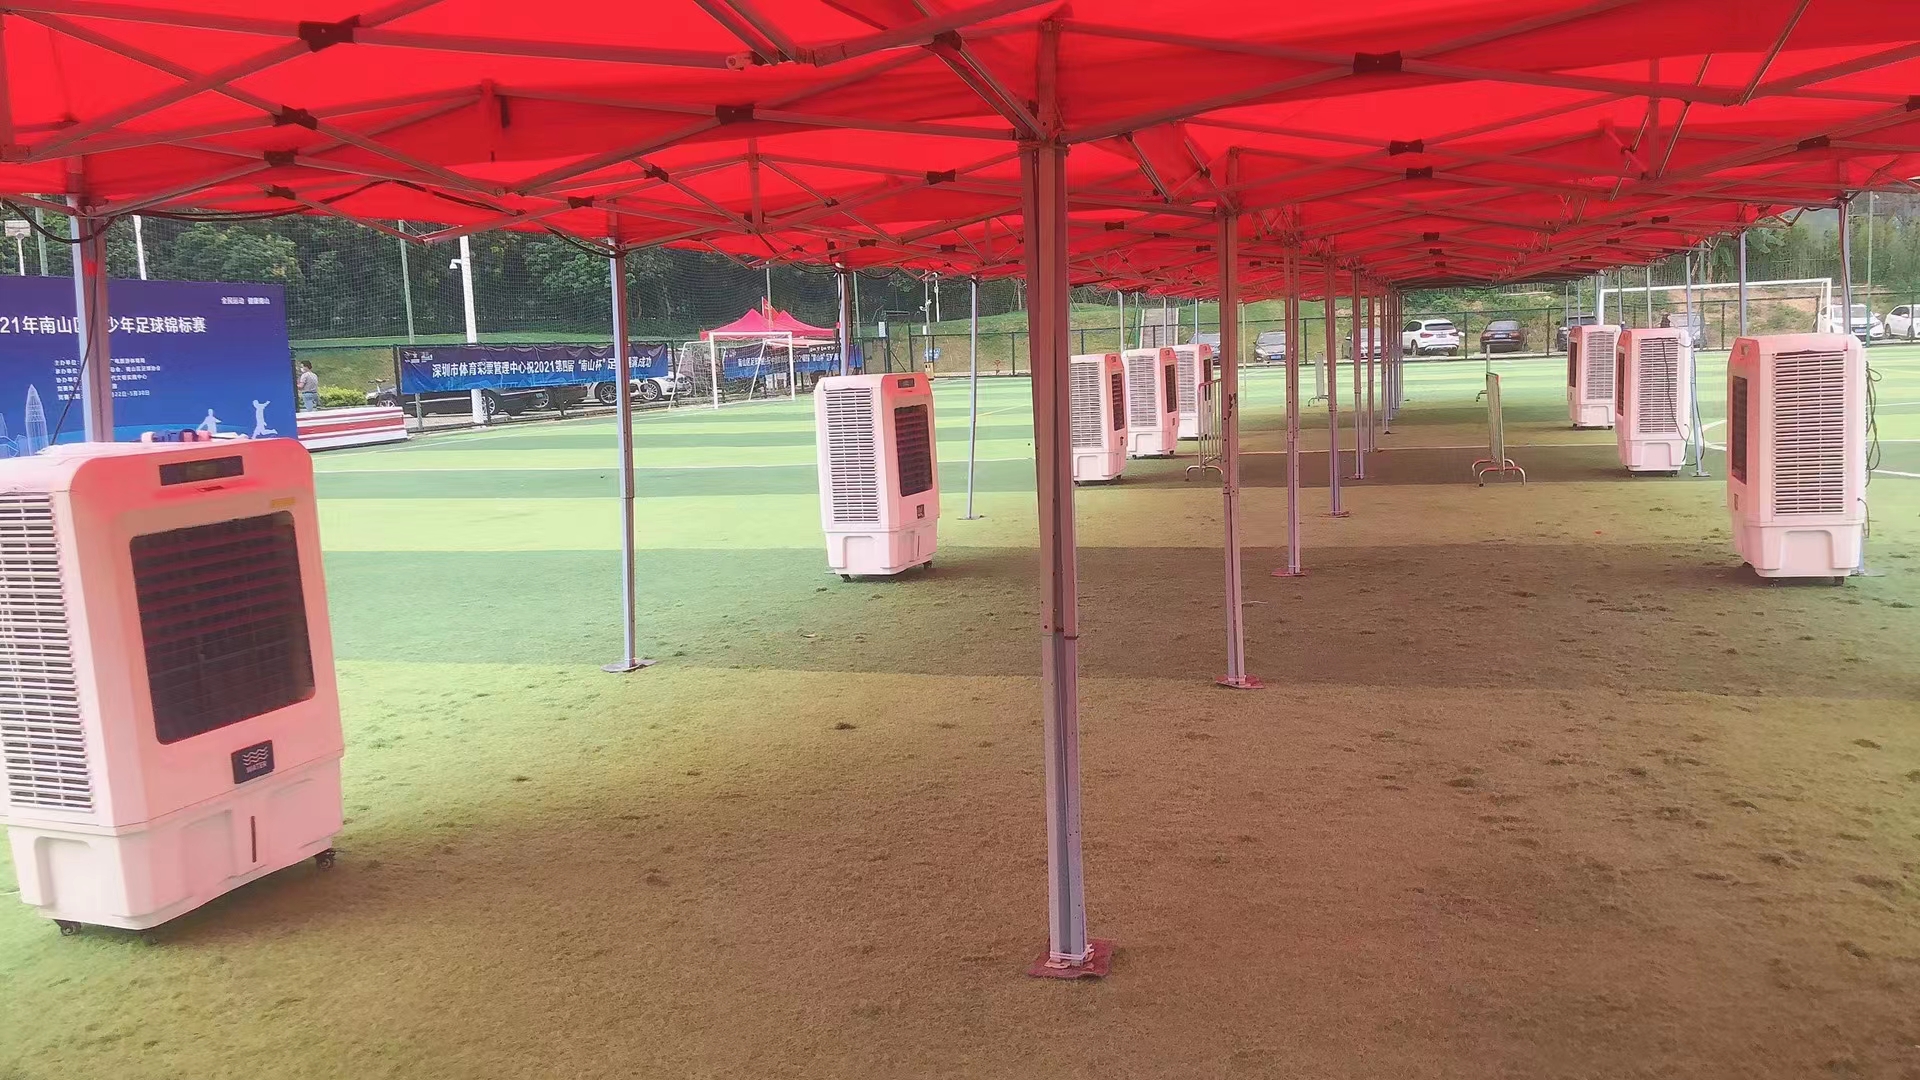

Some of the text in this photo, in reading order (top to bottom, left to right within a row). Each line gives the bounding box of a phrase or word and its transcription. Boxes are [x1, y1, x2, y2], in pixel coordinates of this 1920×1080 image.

[0, 315, 207, 334] 21年南山少年足球锦标赛
